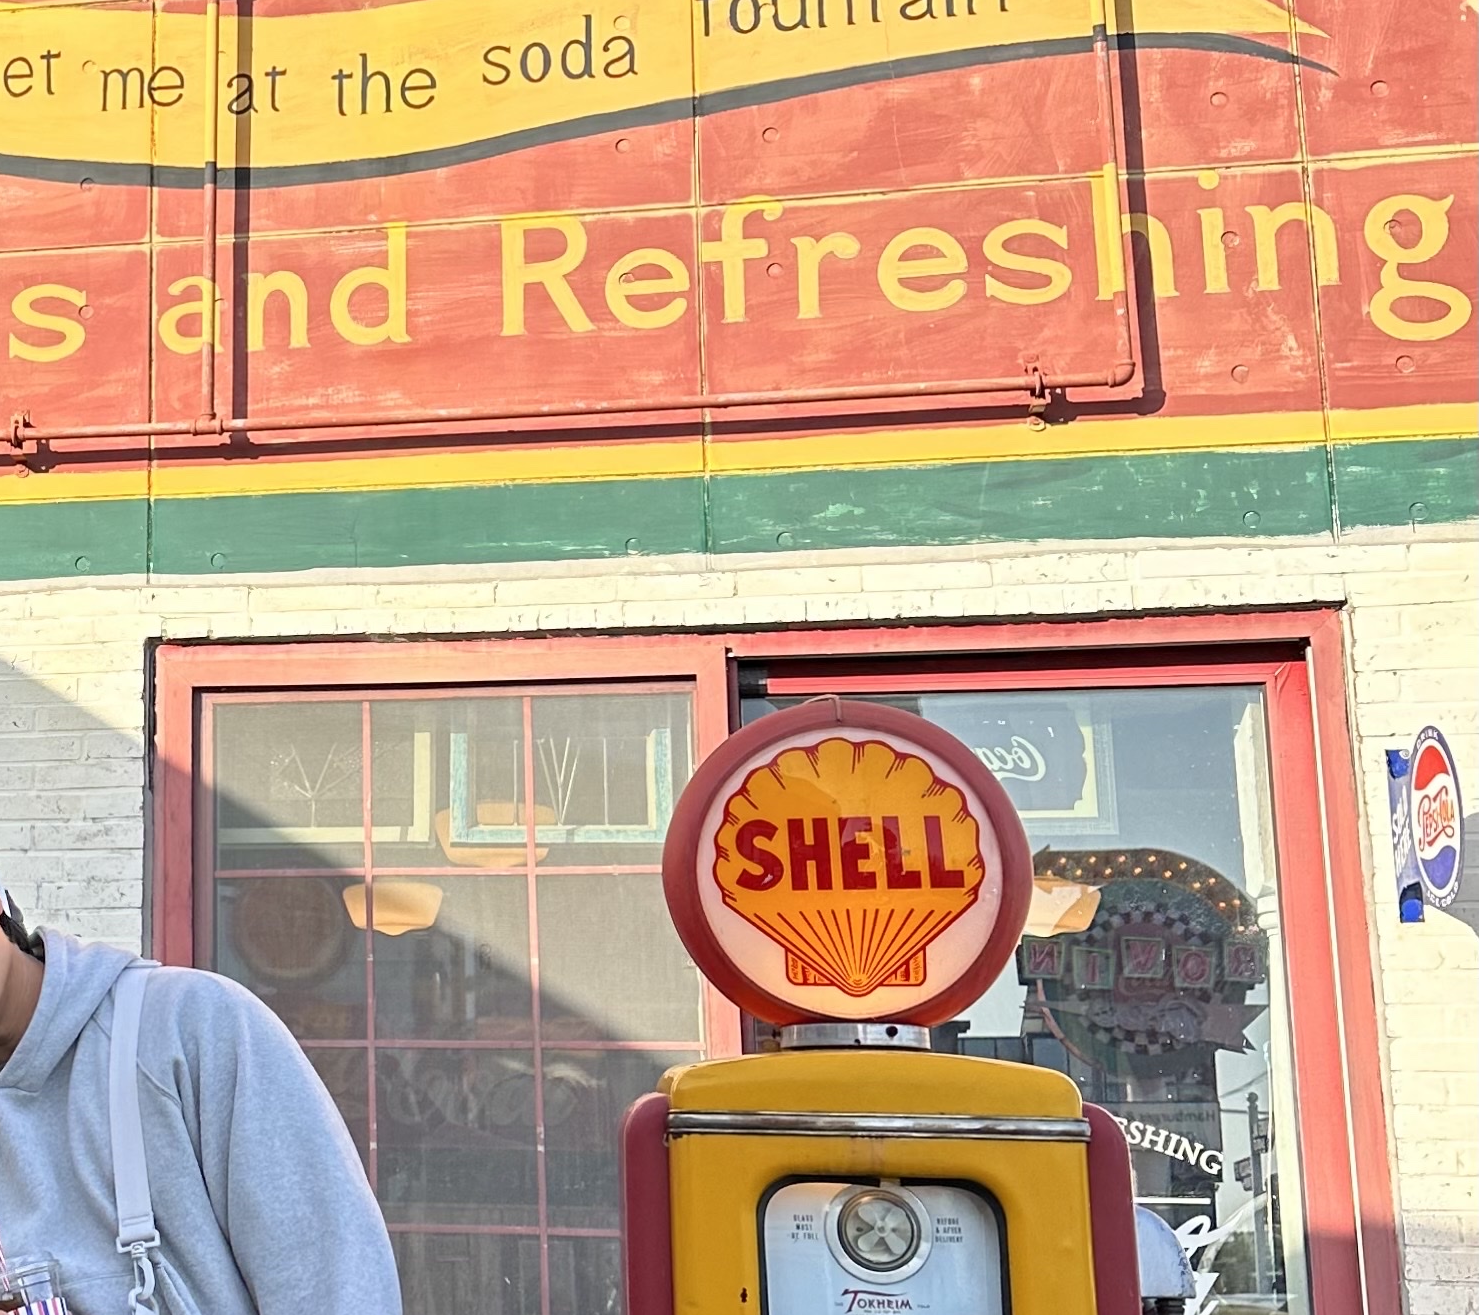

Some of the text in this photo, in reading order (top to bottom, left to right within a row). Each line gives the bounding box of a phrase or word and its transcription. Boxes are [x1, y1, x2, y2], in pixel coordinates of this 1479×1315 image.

[101, 62, 186, 113] me
[226, 64, 288, 117] at
[332, 53, 439, 116] the
[481, 15, 640, 87] soda
[157, 220, 411, 355] and
[500, 161, 1473, 342] Refreshing
[735, 815, 965, 892] SHELL
[841, 1288, 913, 1314] TOKHEIM
